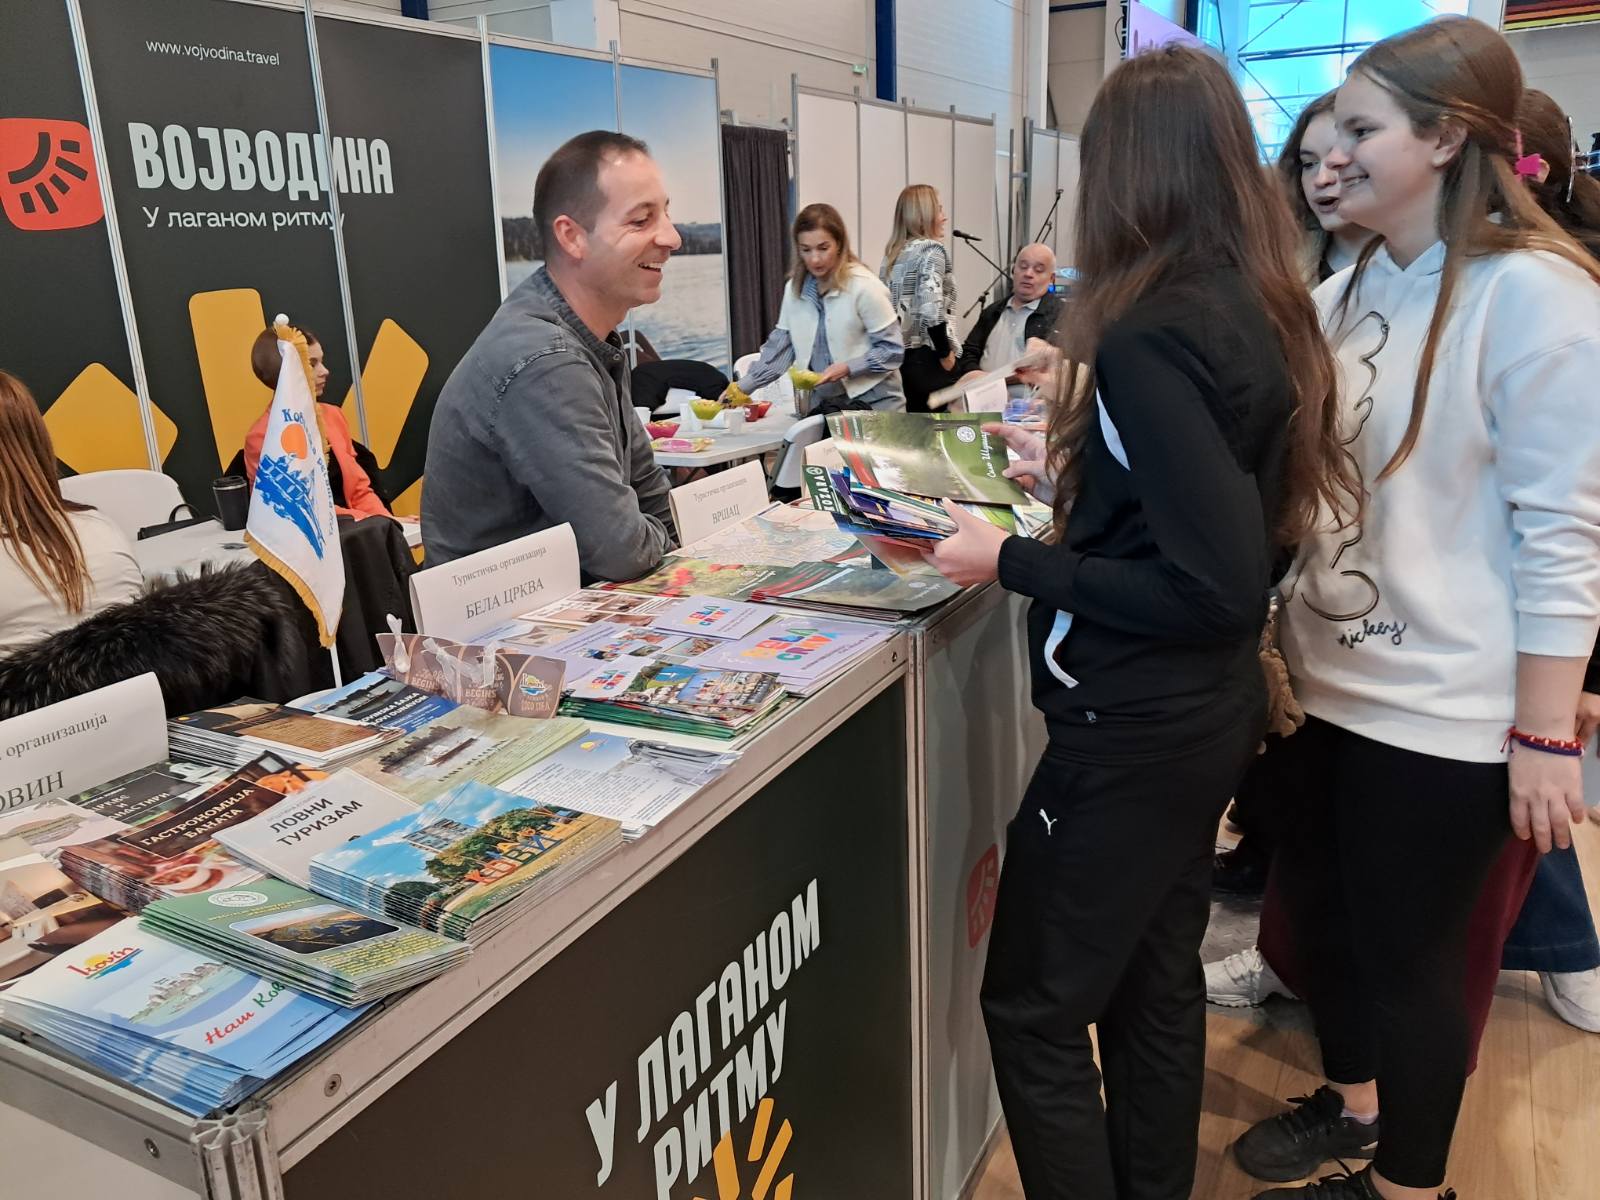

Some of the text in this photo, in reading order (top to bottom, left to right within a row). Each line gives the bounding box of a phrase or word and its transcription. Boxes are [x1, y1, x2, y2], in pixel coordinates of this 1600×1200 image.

[145, 39, 280, 66] www.vojvodina.travel
[127, 122, 394, 201] ВОЈВОДИНА
[142, 206, 345, 232] У лаганом ритму
[711, 503, 741, 525] ВРШАЦ
[451, 546, 547, 587] Туристичка организација
[465, 577, 545, 619] БЕЛА ЦРКВА
[6, 713, 108, 758] организација
[108, 792, 171, 819] АНАСТИРИ
[140, 785, 255, 847] ГАСТРОНОМИЈА
[183, 808, 244, 840] БАНАТА
[269, 797, 334, 834] ЛОВНИ
[276, 800, 364, 846] ТУРИЗАМ
[204, 1009, 255, 1046] Наш
[585, 878, 821, 1188] У ЛАГАНОМ
[653, 998, 787, 1200] РИТМУ
